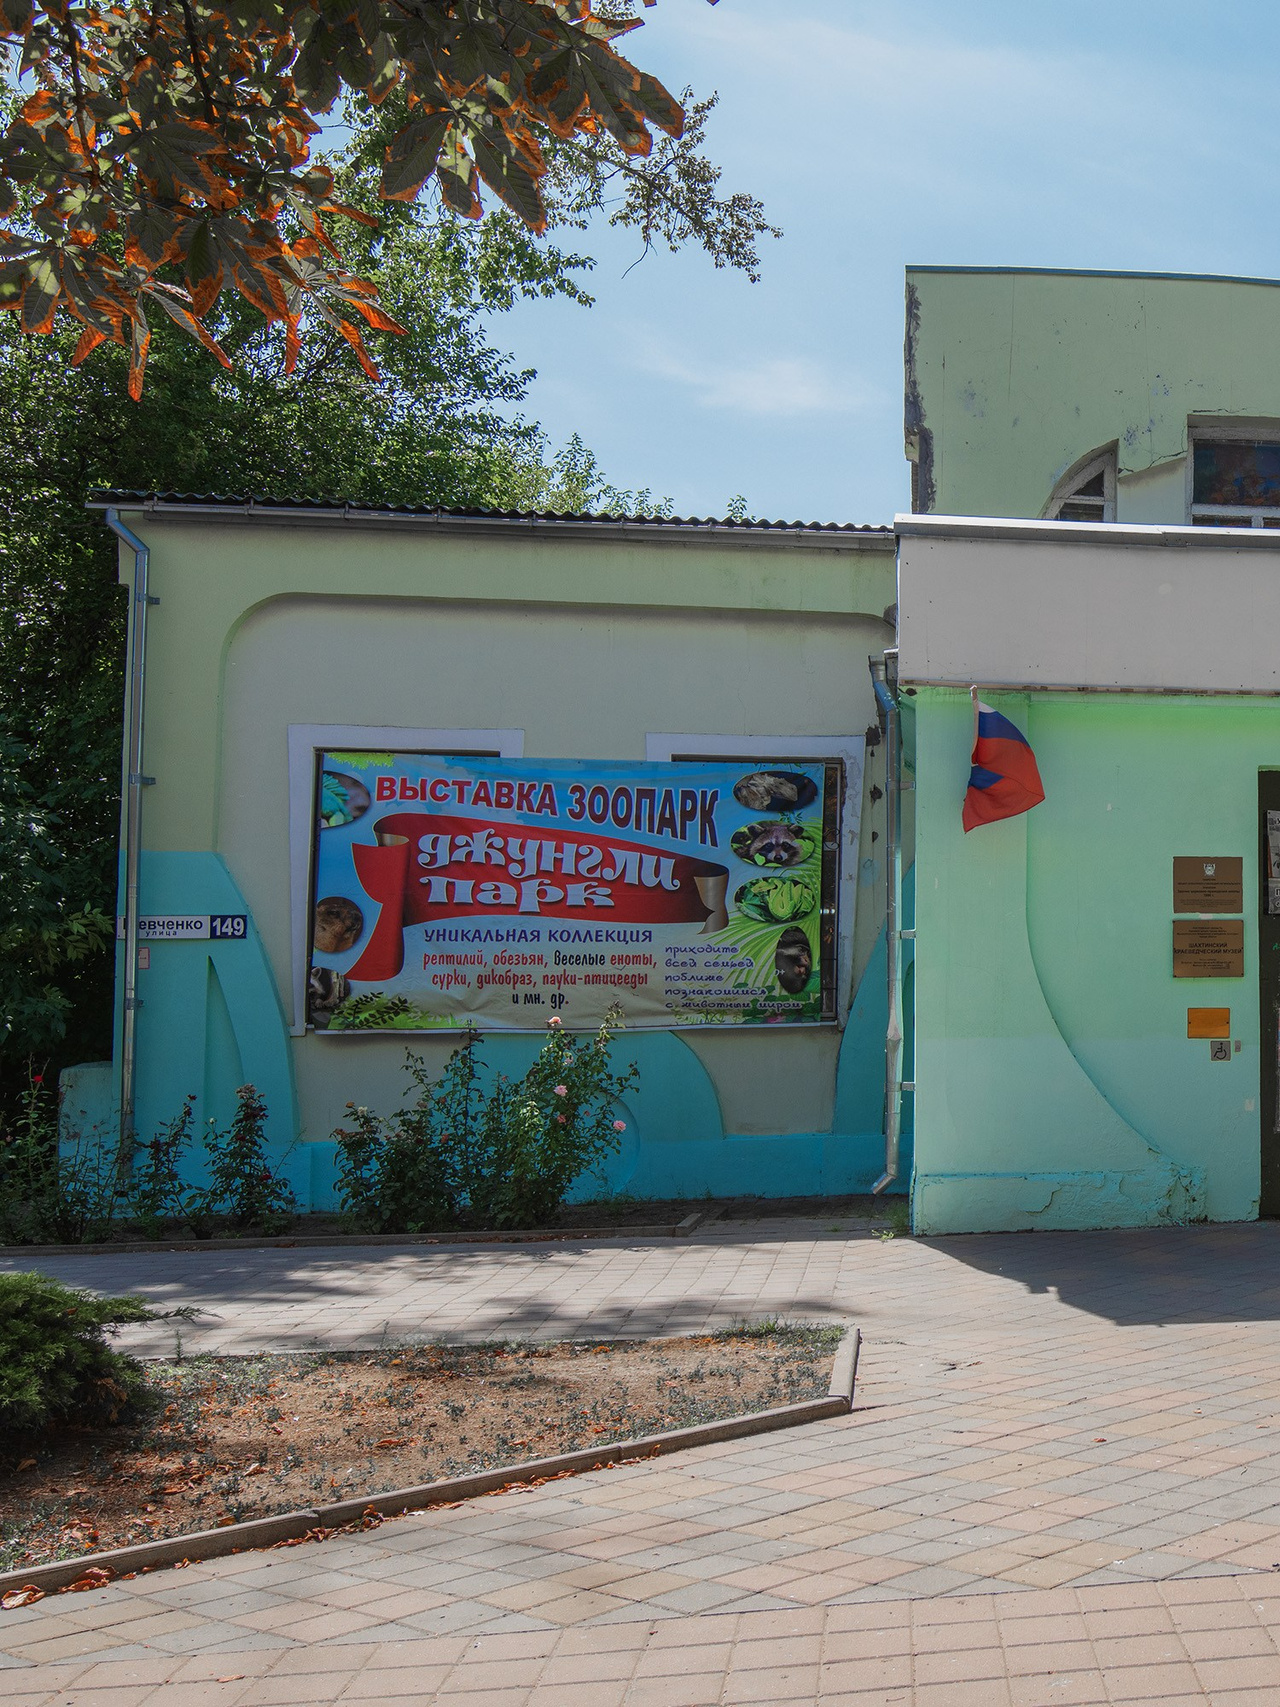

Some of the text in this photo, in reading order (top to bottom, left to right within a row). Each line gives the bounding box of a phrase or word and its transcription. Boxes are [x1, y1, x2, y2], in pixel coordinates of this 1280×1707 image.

[375, 777, 720, 849] ВЫСТАВКА ЗООПАРК
[145, 930, 178, 938] улица
[212, 917, 245, 936] 149
[424, 928, 653, 945] УНИКАЛЬНАЯ КОЛЛЕКЦИЯ
[423, 949, 488, 970] рептилий,
[493, 949, 549, 969] обезьян,
[610, 951, 658, 969] еноты,
[665, 944, 739, 959] приходите
[665, 958, 698, 969] всей
[432, 970, 648, 990] сурки, дикобраз, пауки-птицееды
[665, 973, 725, 983] поближе
[512, 993, 570, 1010] и мн. др.
